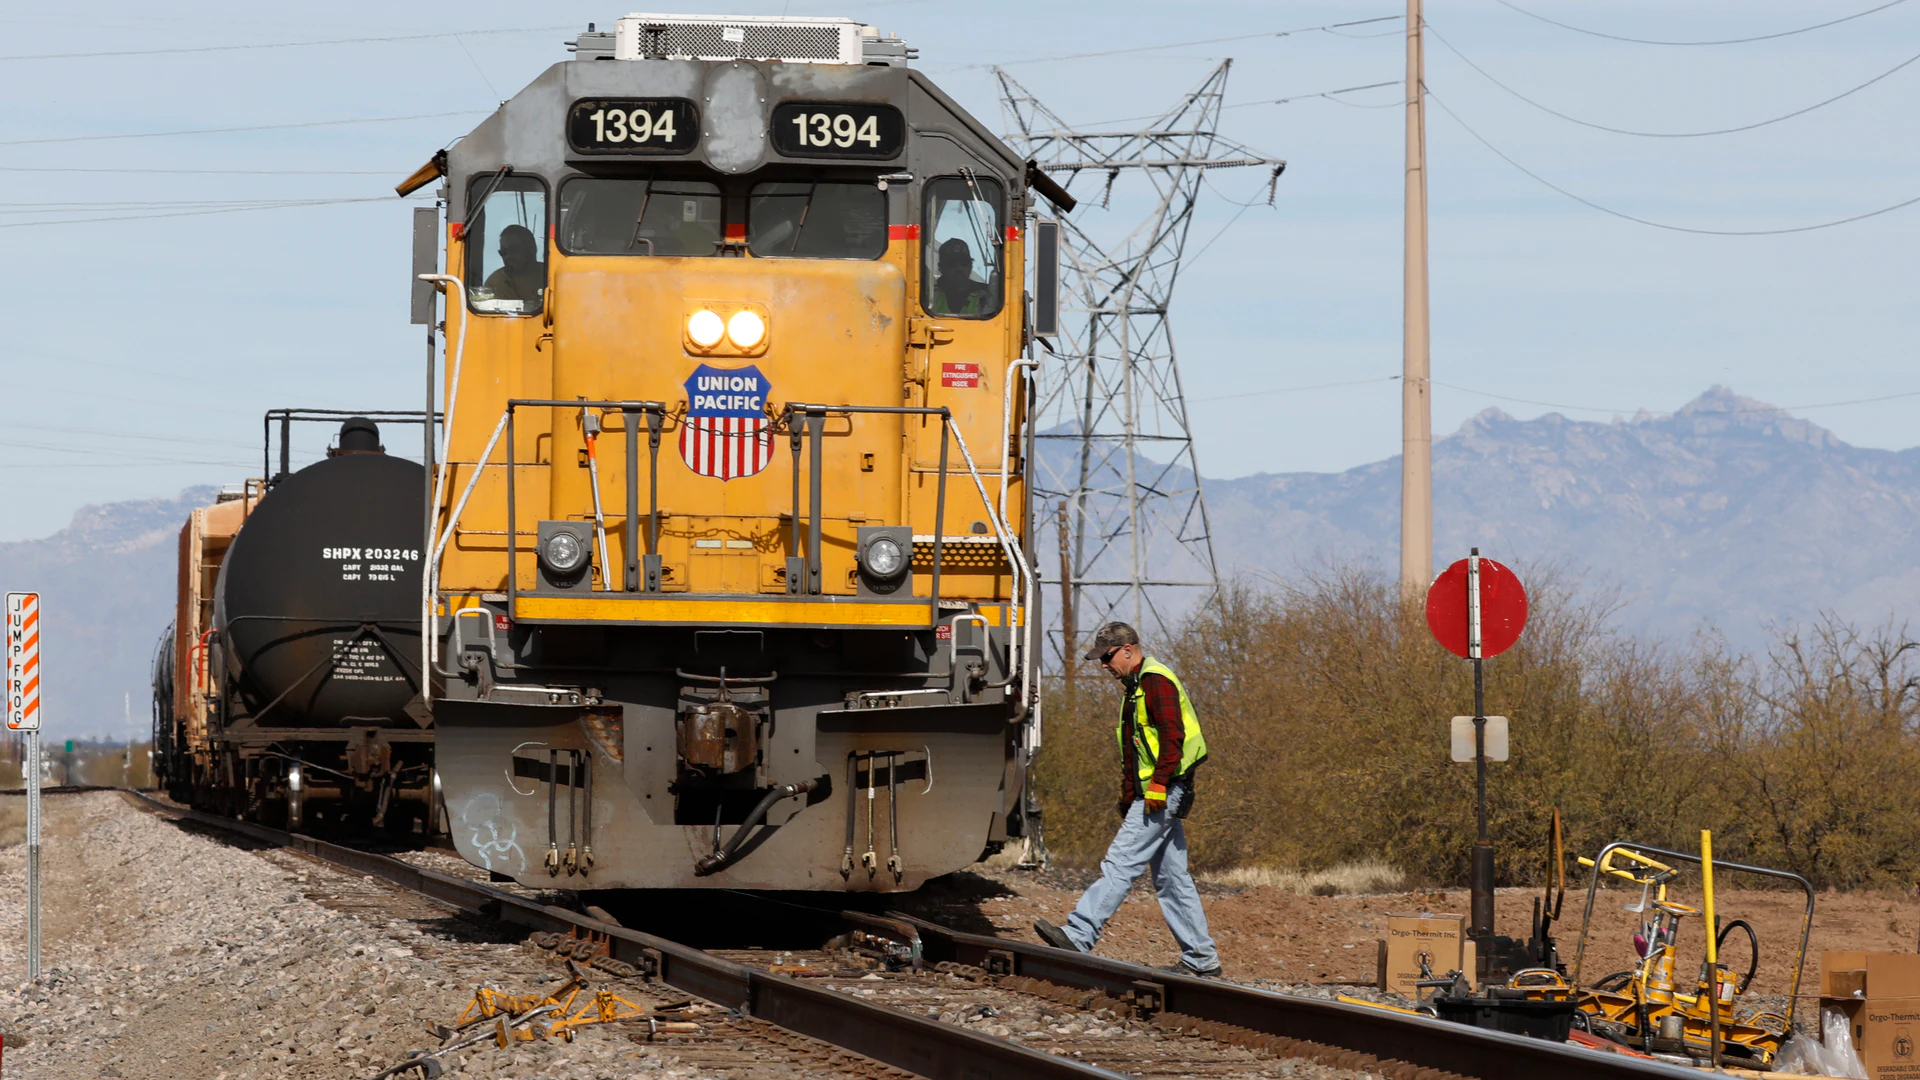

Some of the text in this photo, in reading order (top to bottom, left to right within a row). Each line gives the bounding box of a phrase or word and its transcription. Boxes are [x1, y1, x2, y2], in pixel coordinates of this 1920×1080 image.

[590, 108, 677, 143] 1394
[792, 113, 881, 148] 1394
[698, 376, 757, 392] UNION
[694, 395, 761, 410] PACIFIC
[323, 548, 419, 561] SHPX 203246
[13, 599, 21, 657] JUMP
